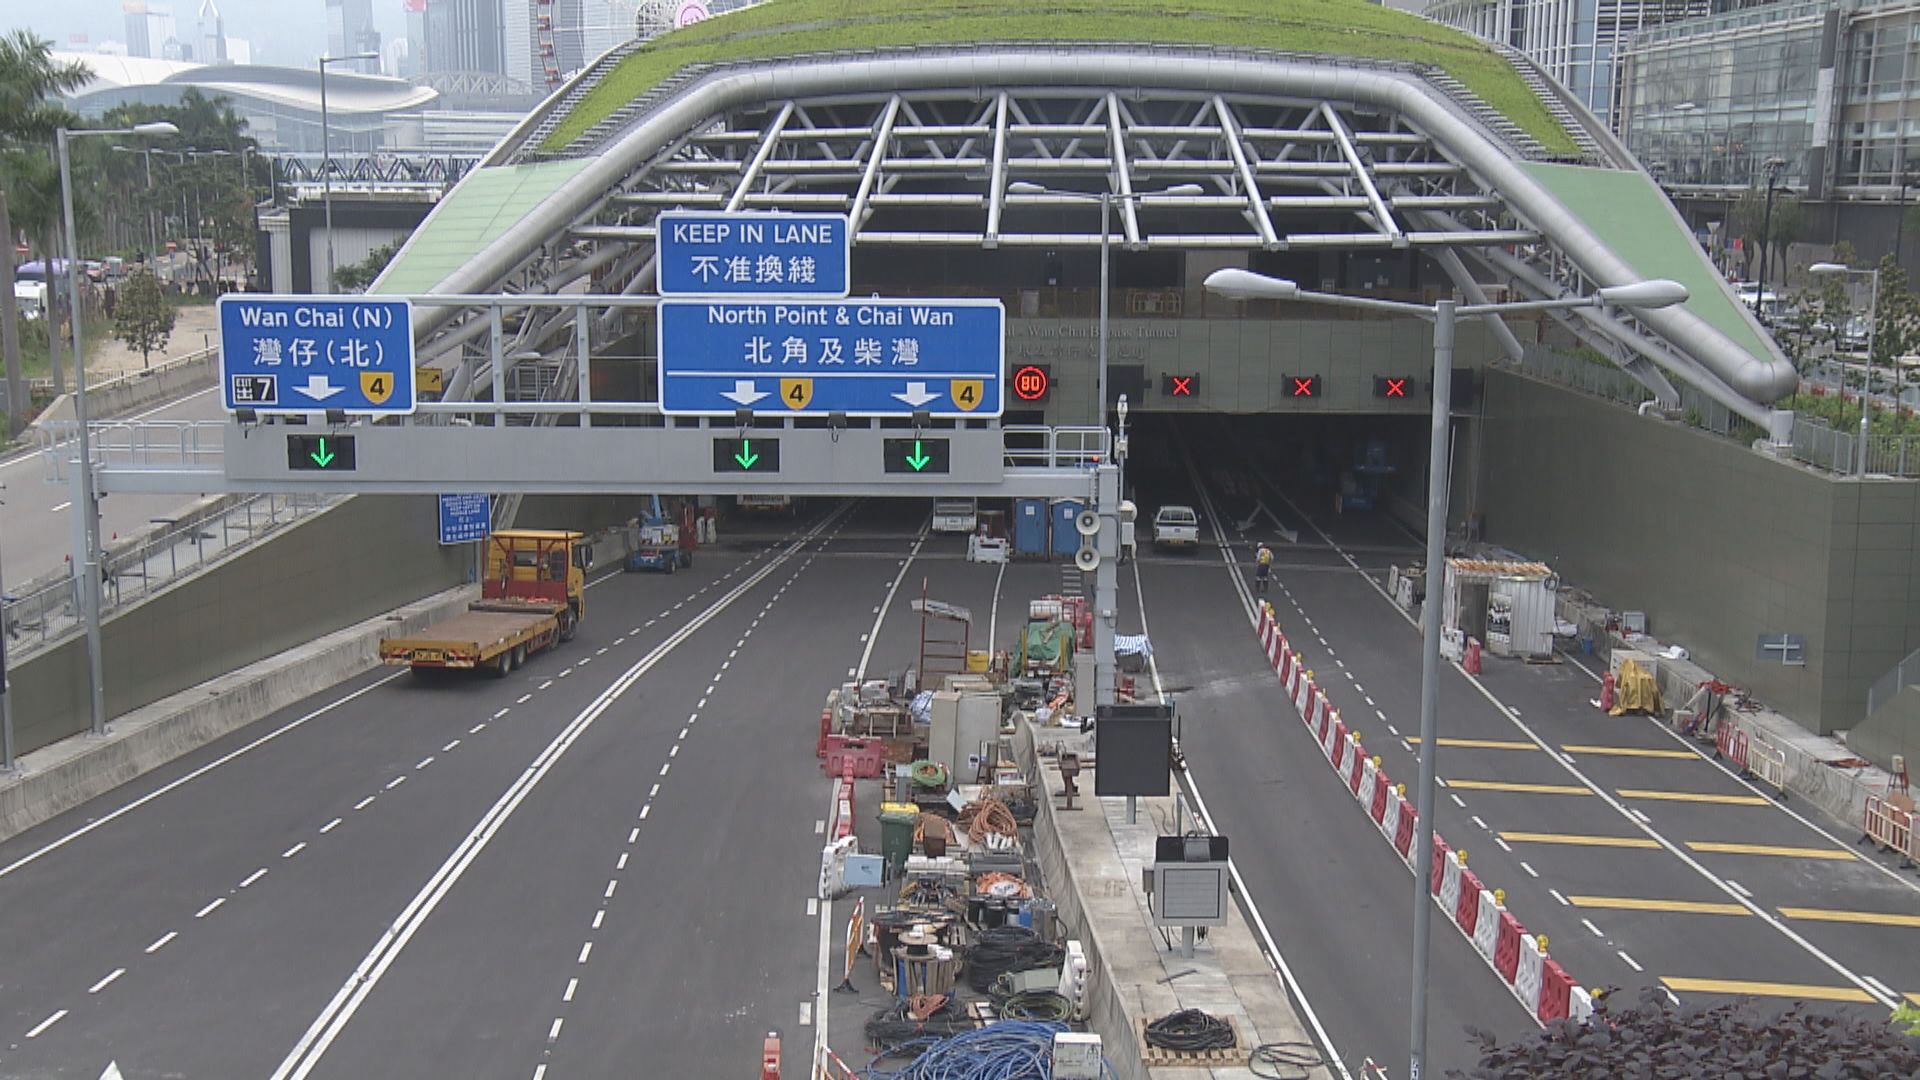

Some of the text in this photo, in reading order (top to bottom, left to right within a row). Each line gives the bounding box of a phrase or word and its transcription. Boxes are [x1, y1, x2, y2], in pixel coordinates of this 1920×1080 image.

[674, 224, 832, 243] KEEP IN LANE
[240, 305, 392, 330] Wan Chai (N)
[707, 305, 954, 326] North Point & Chai Wan
[1138, 325, 1178, 338] Tunnel
[744, 336, 919, 366] 北角及柴灣
[256, 377, 271, 401] 7
[369, 377, 385, 395] 4
[1021, 375, 1040, 392] 80
[789, 384, 804, 402] 4
[959, 385, 974, 403] 4
